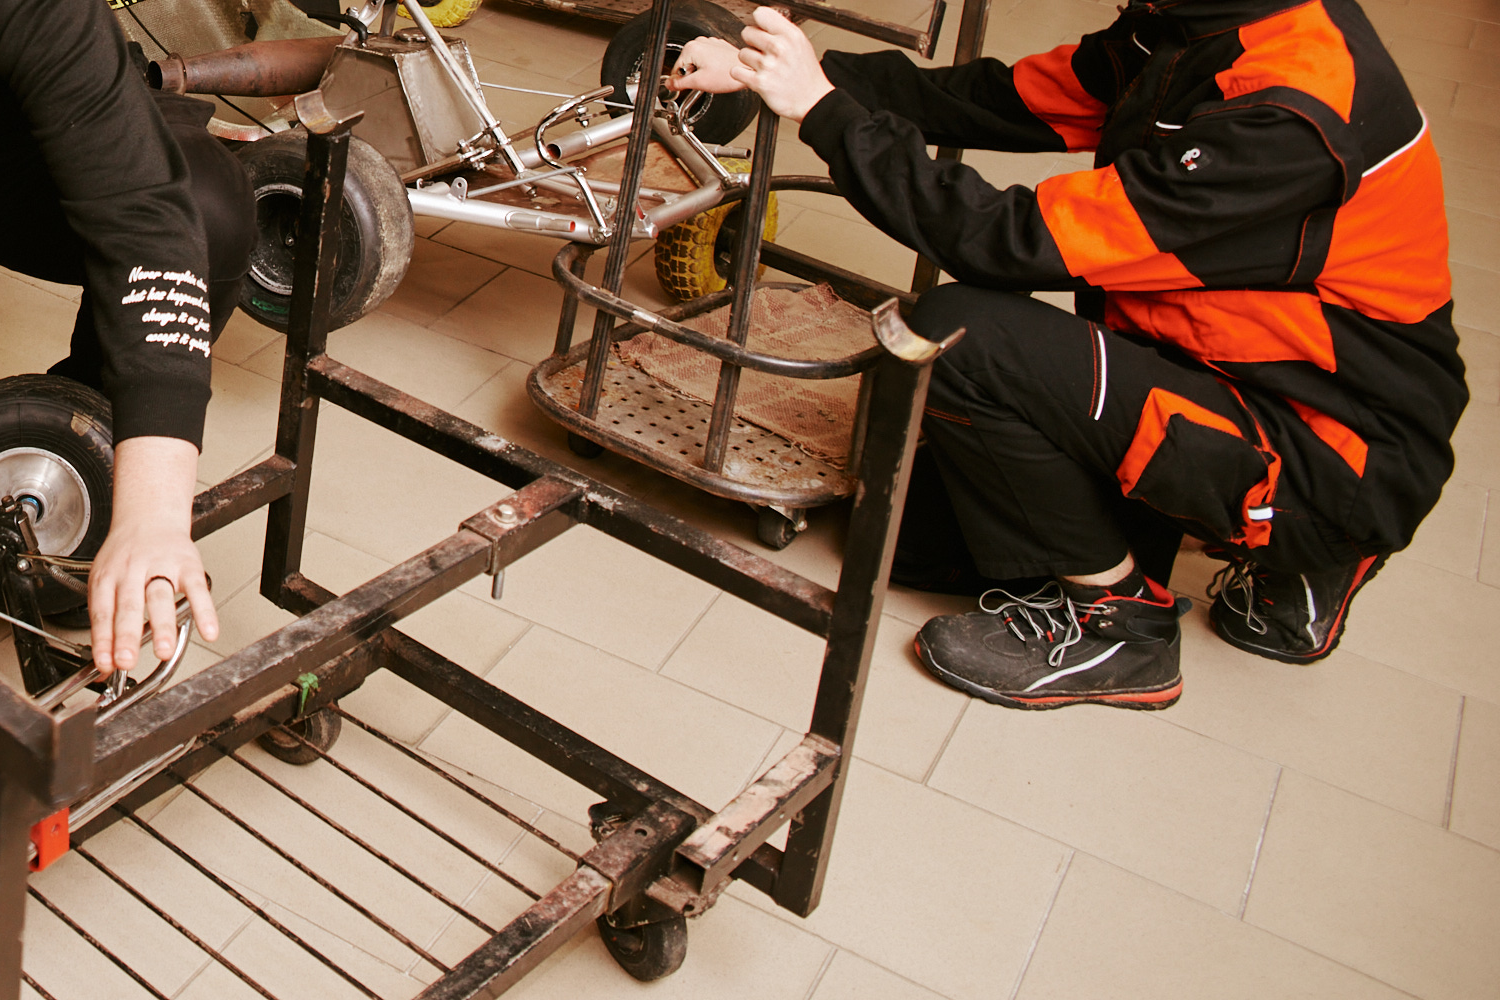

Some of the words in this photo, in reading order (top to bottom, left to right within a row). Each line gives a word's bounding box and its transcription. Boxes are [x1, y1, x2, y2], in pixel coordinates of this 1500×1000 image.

[128, 265, 162, 284] Never
[121, 289, 148, 305] what
[146, 286, 167, 301] has
[141, 307, 177, 327] change
[177, 311, 189, 323] it
[187, 316, 198, 326] or
[145, 332, 180, 347] accept
[179, 333, 190, 345] it
